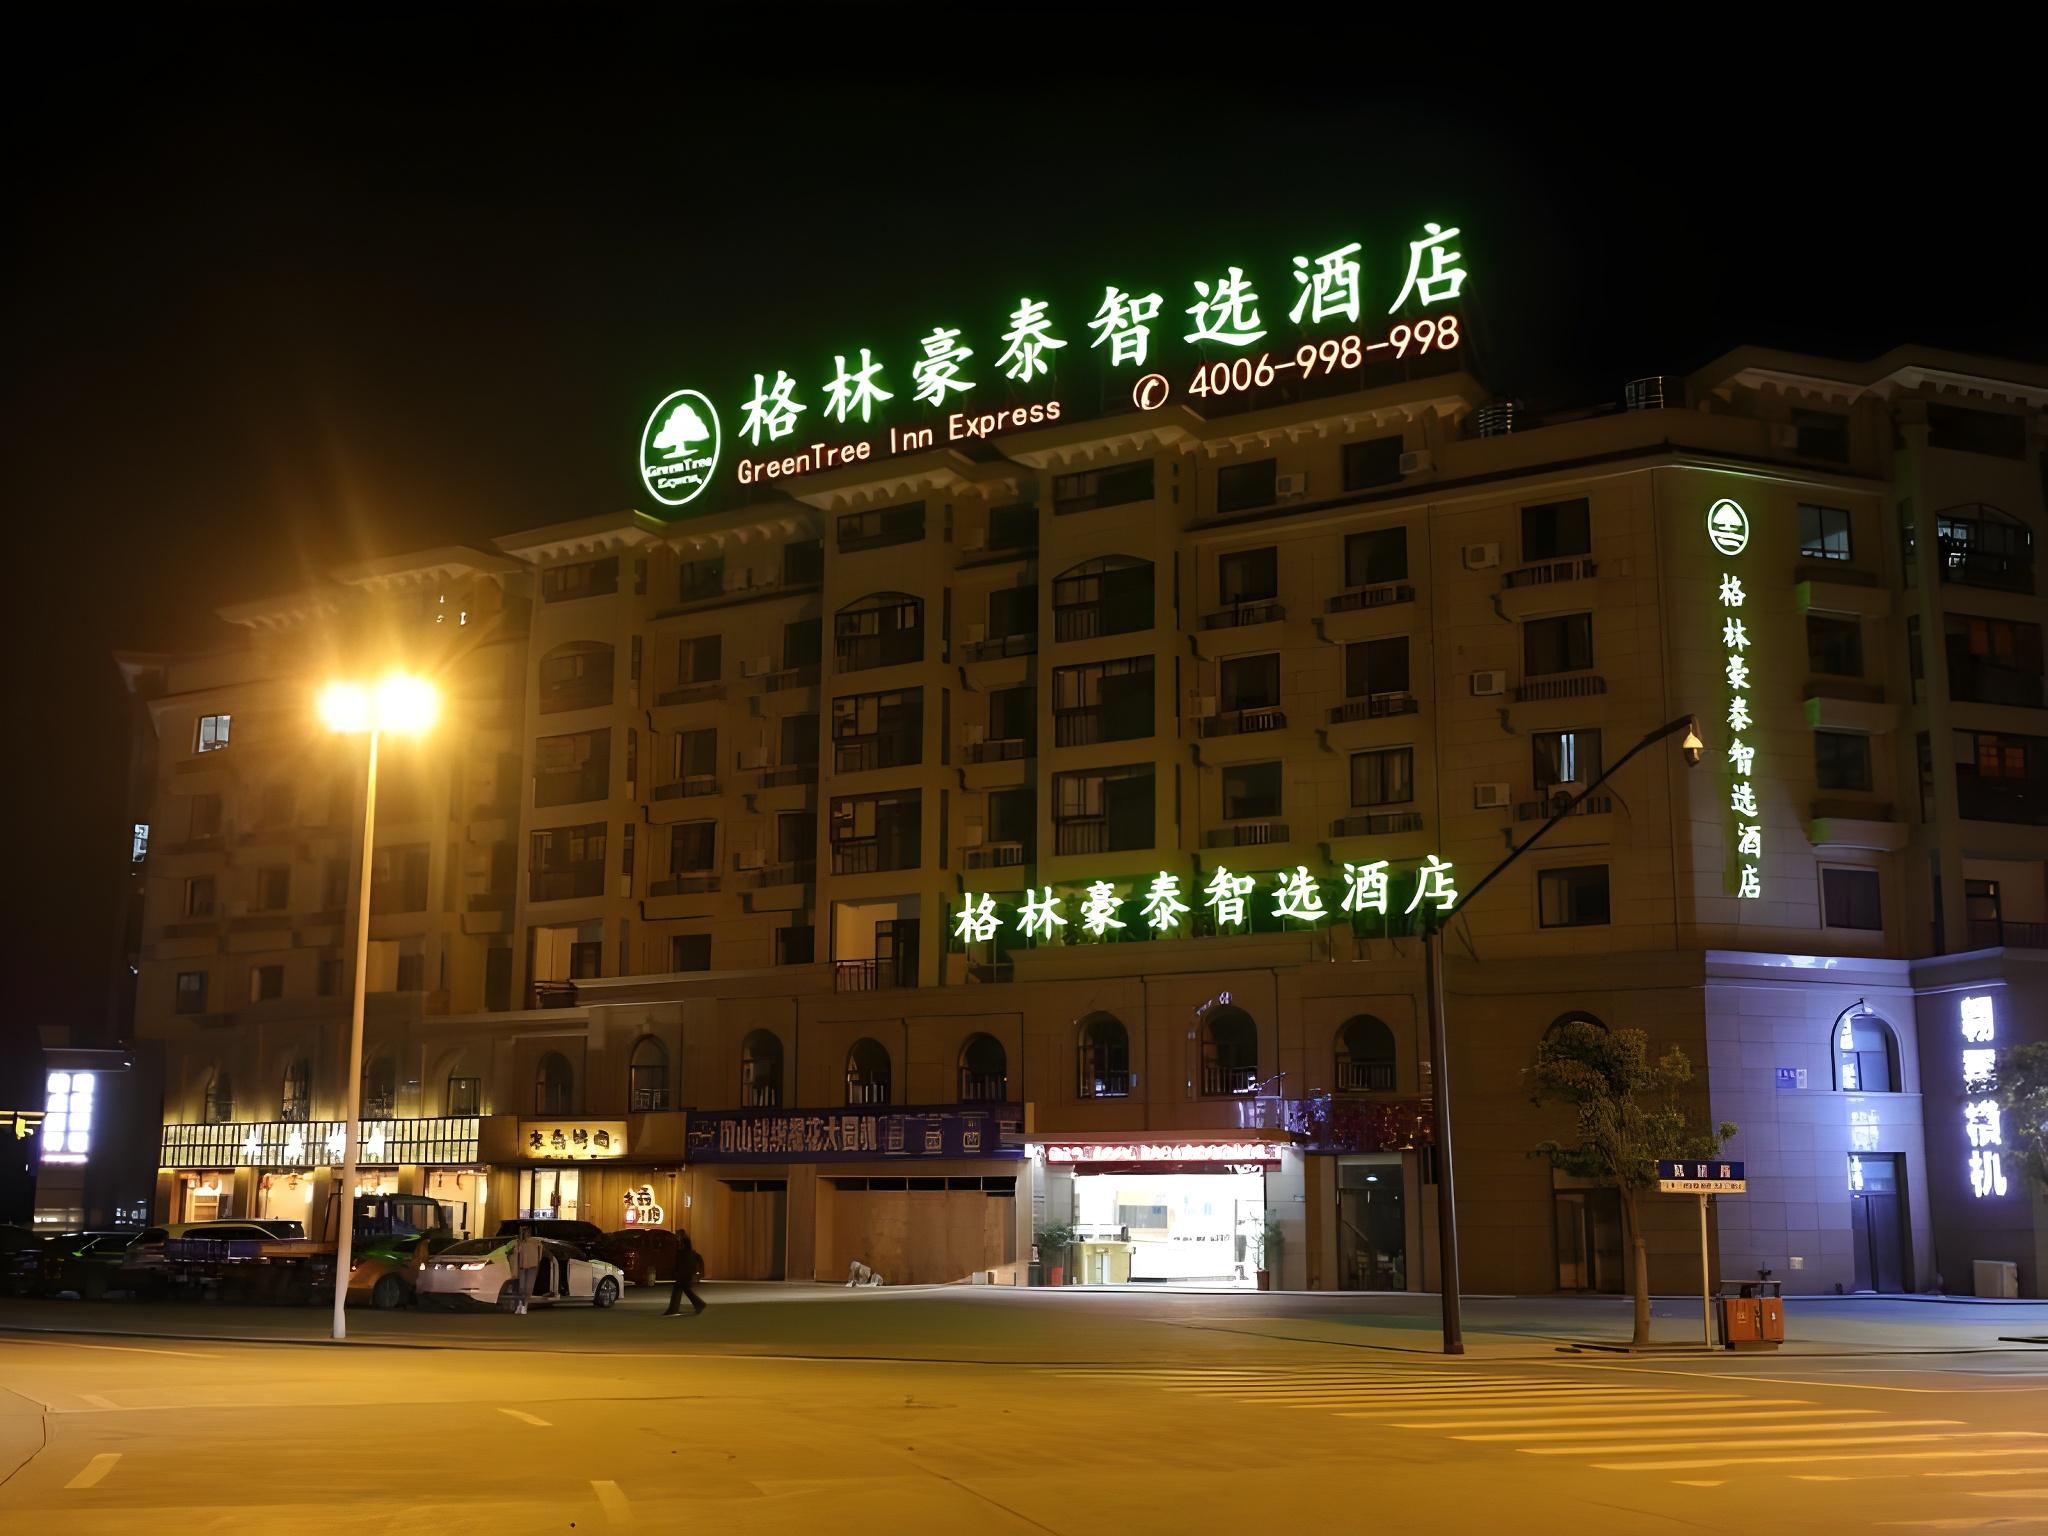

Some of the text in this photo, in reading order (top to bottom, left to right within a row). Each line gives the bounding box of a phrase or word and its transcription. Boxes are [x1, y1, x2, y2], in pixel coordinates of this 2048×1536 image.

[738, 222, 1468, 447] 格林豪泰智选酒店
[1188, 314, 1460, 398] 4006-998-998
[738, 400, 1061, 485] GreenTree Inn Express
[1718, 572, 1762, 899] 格林豪泰智选酒店
[954, 854, 1458, 943] 格林豪泰智选酒店
